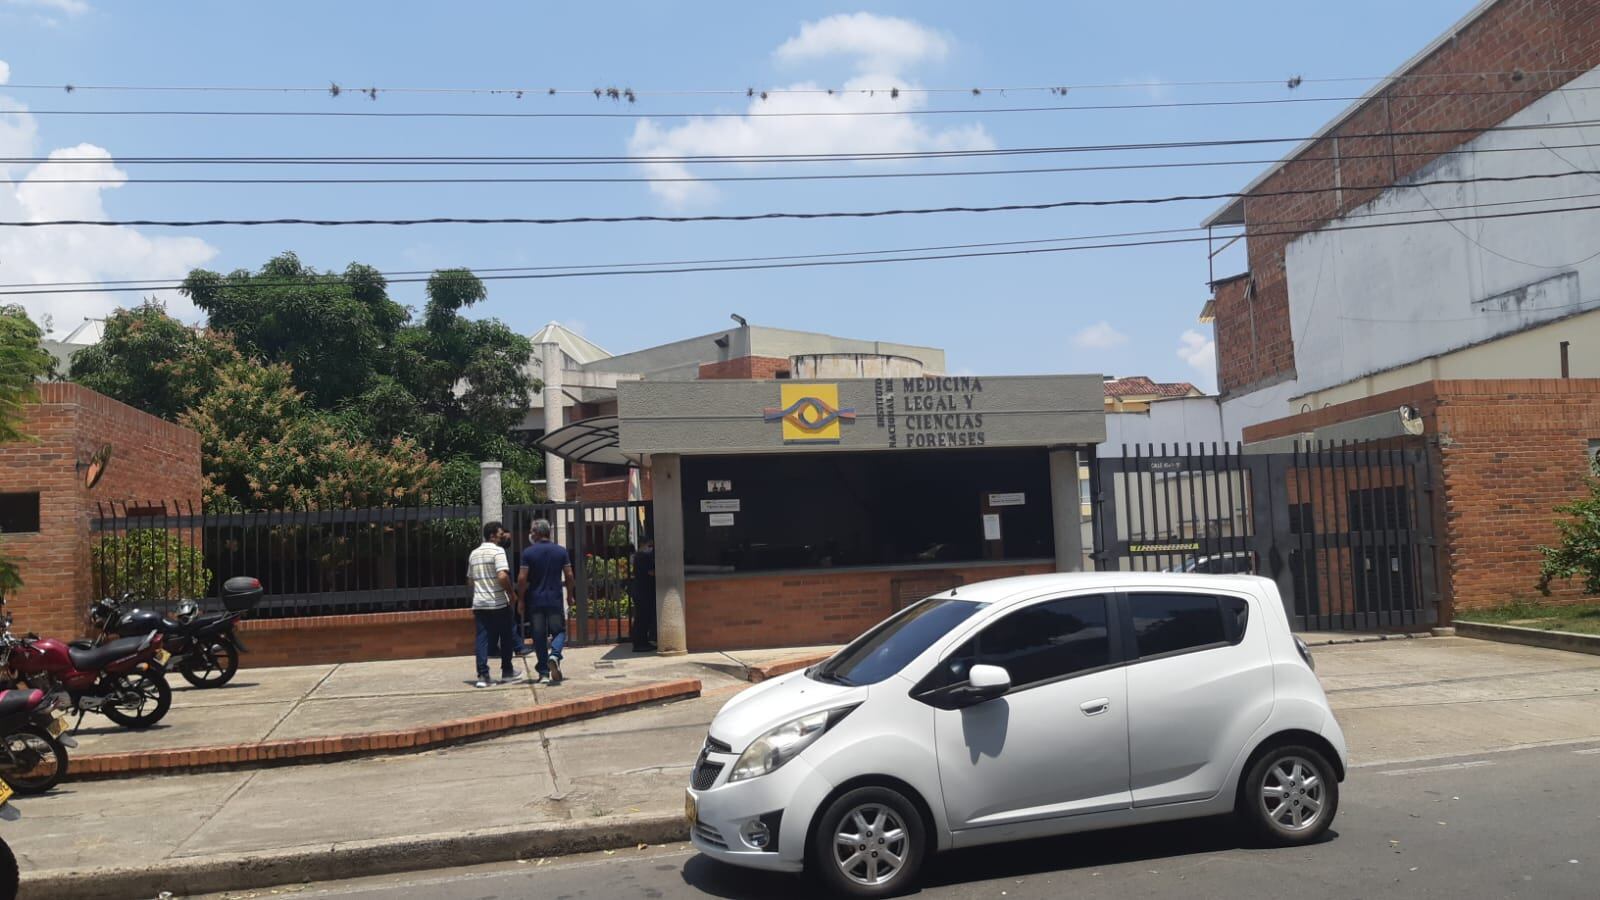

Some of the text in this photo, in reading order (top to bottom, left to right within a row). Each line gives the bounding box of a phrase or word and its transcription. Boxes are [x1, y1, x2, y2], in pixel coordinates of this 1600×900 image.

[903, 377, 982, 392] MEDICINA
[875, 378, 884, 428] INSTITUTO
[904, 394, 973, 411] LEGAL Y
[885, 378, 896, 448] NACIONAL DE
[906, 414, 983, 429] CIENCIAS
[906, 432, 985, 447] FORENSES
